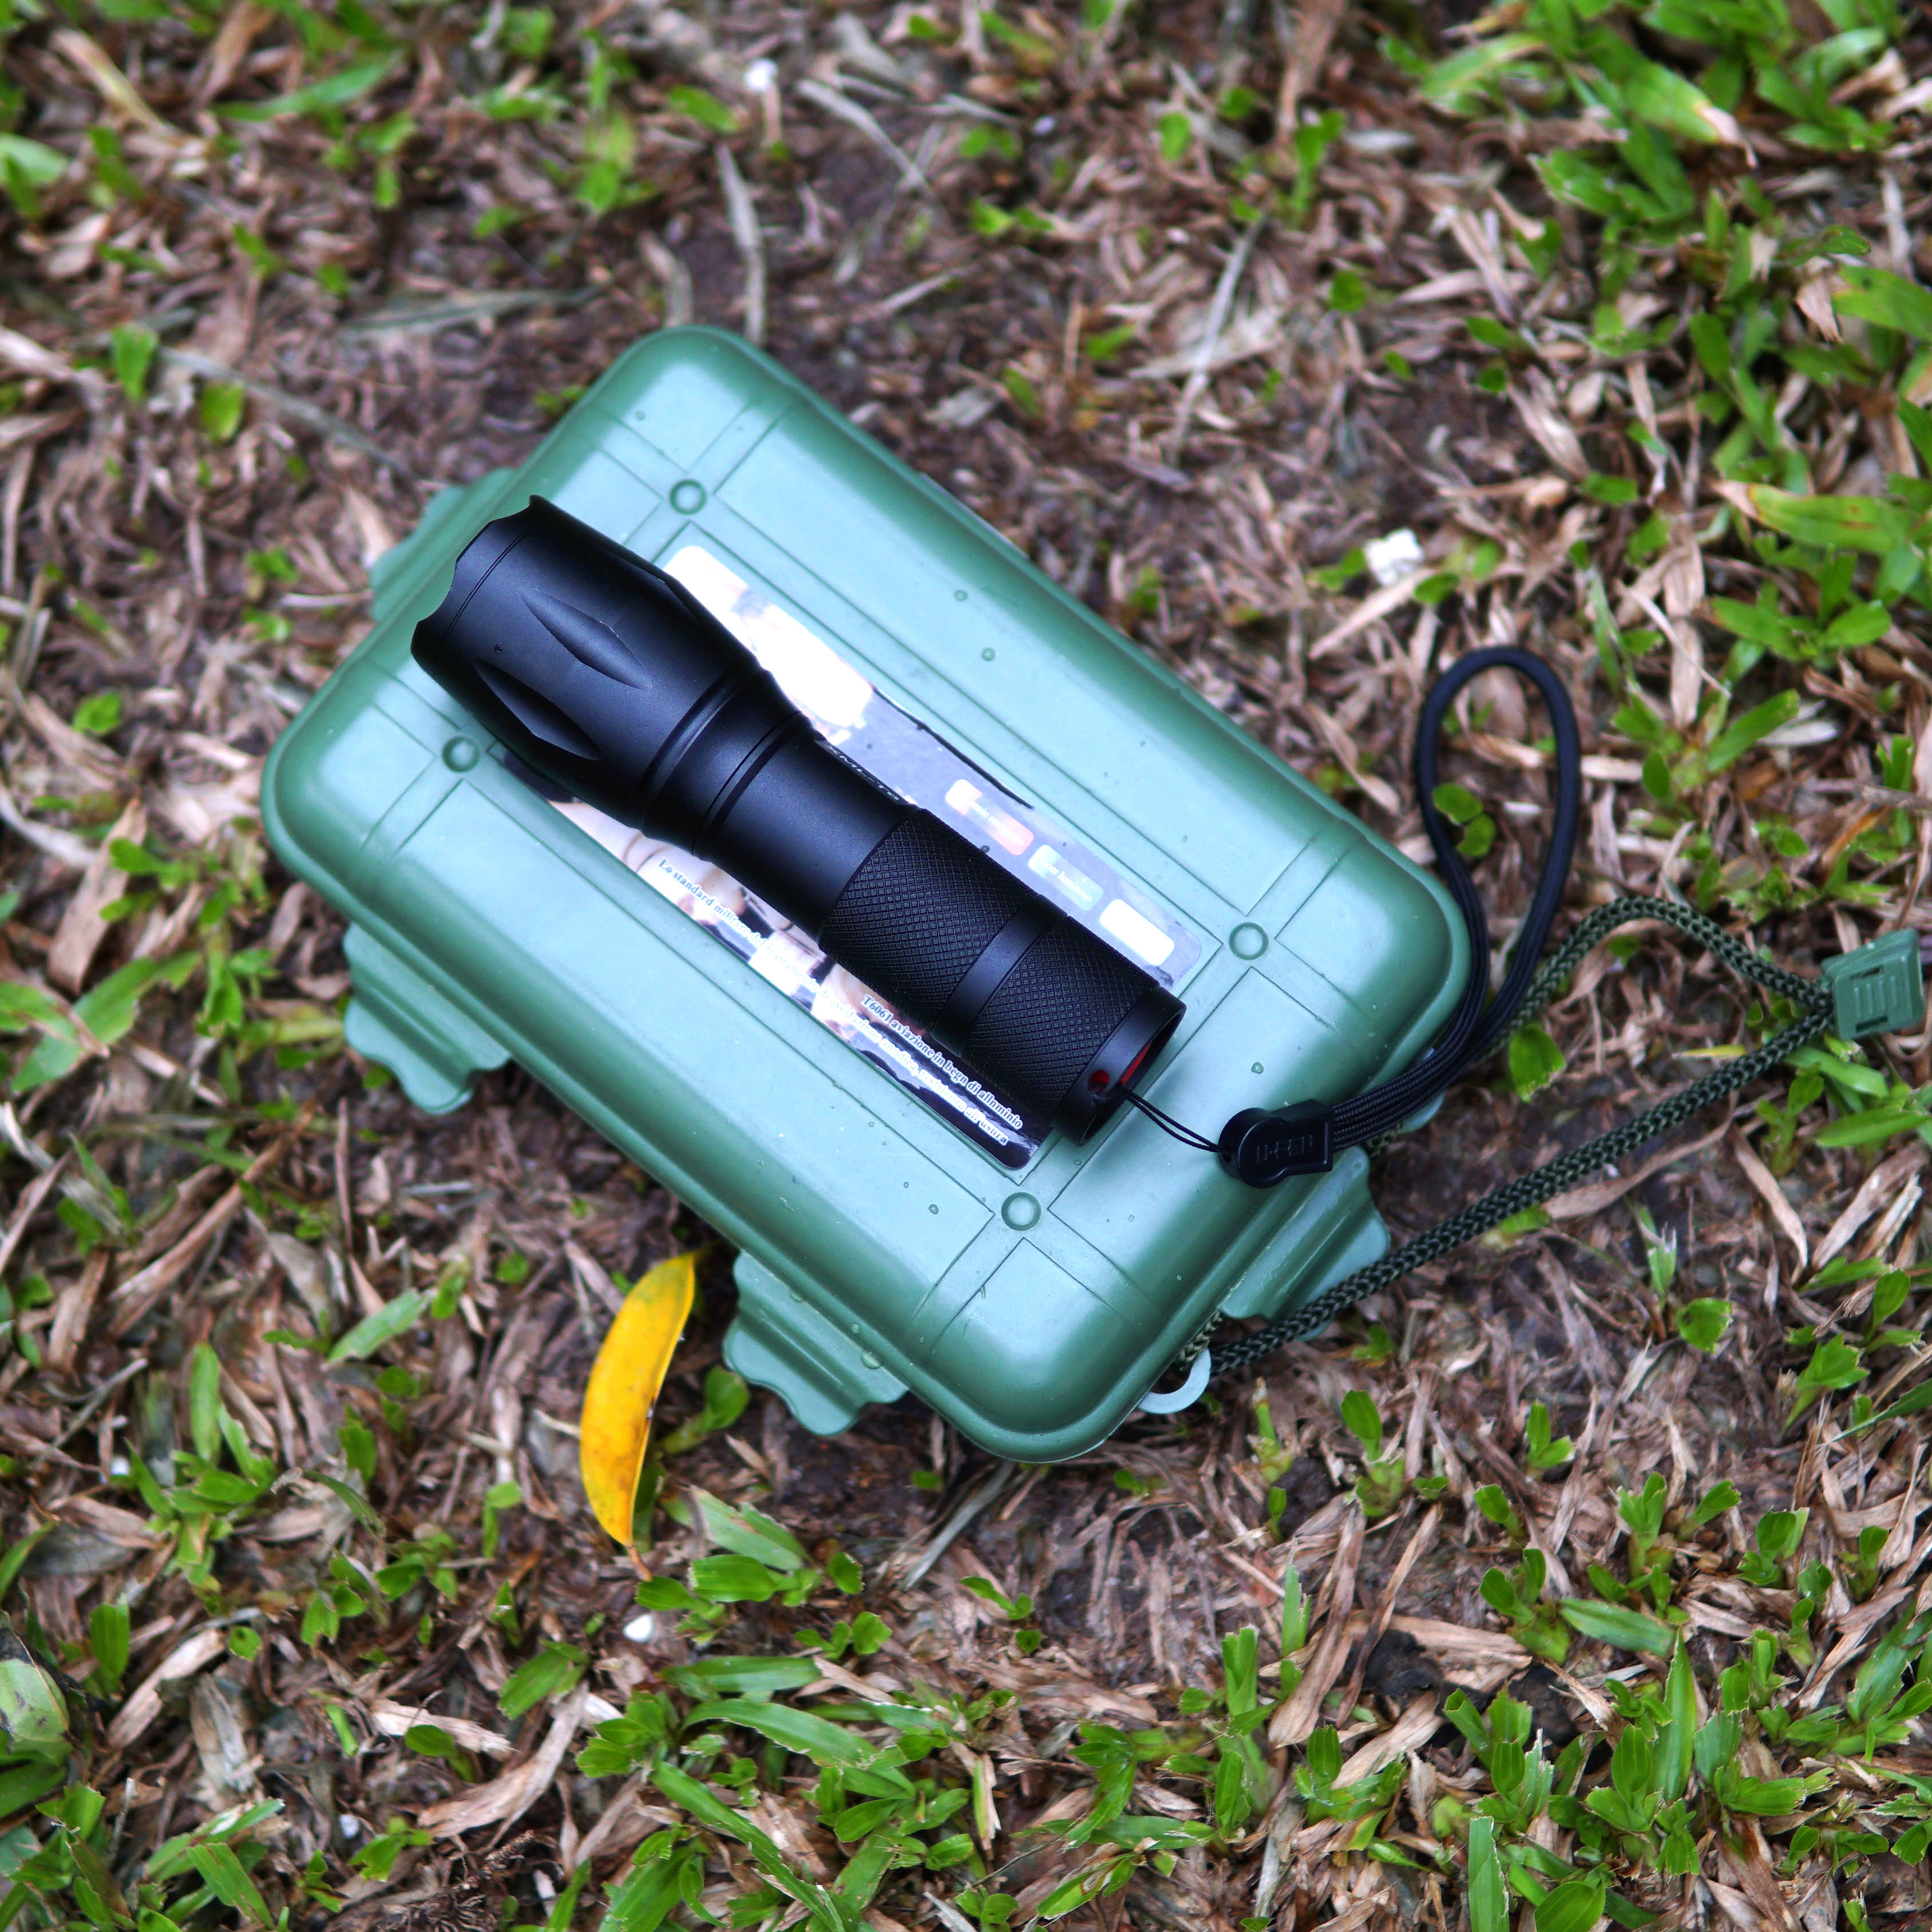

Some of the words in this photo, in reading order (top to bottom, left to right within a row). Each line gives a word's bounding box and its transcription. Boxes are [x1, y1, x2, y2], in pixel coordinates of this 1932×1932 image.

[658, 860, 673, 873] Lo
[672, 871, 715, 906] standard
[714, 904, 752, 936] militare
[862, 996, 892, 1022] T6061
[891, 1020, 935, 1057] aviazione
[933, 1053, 946, 1066] in
[968, 1080, 980, 1094] di
